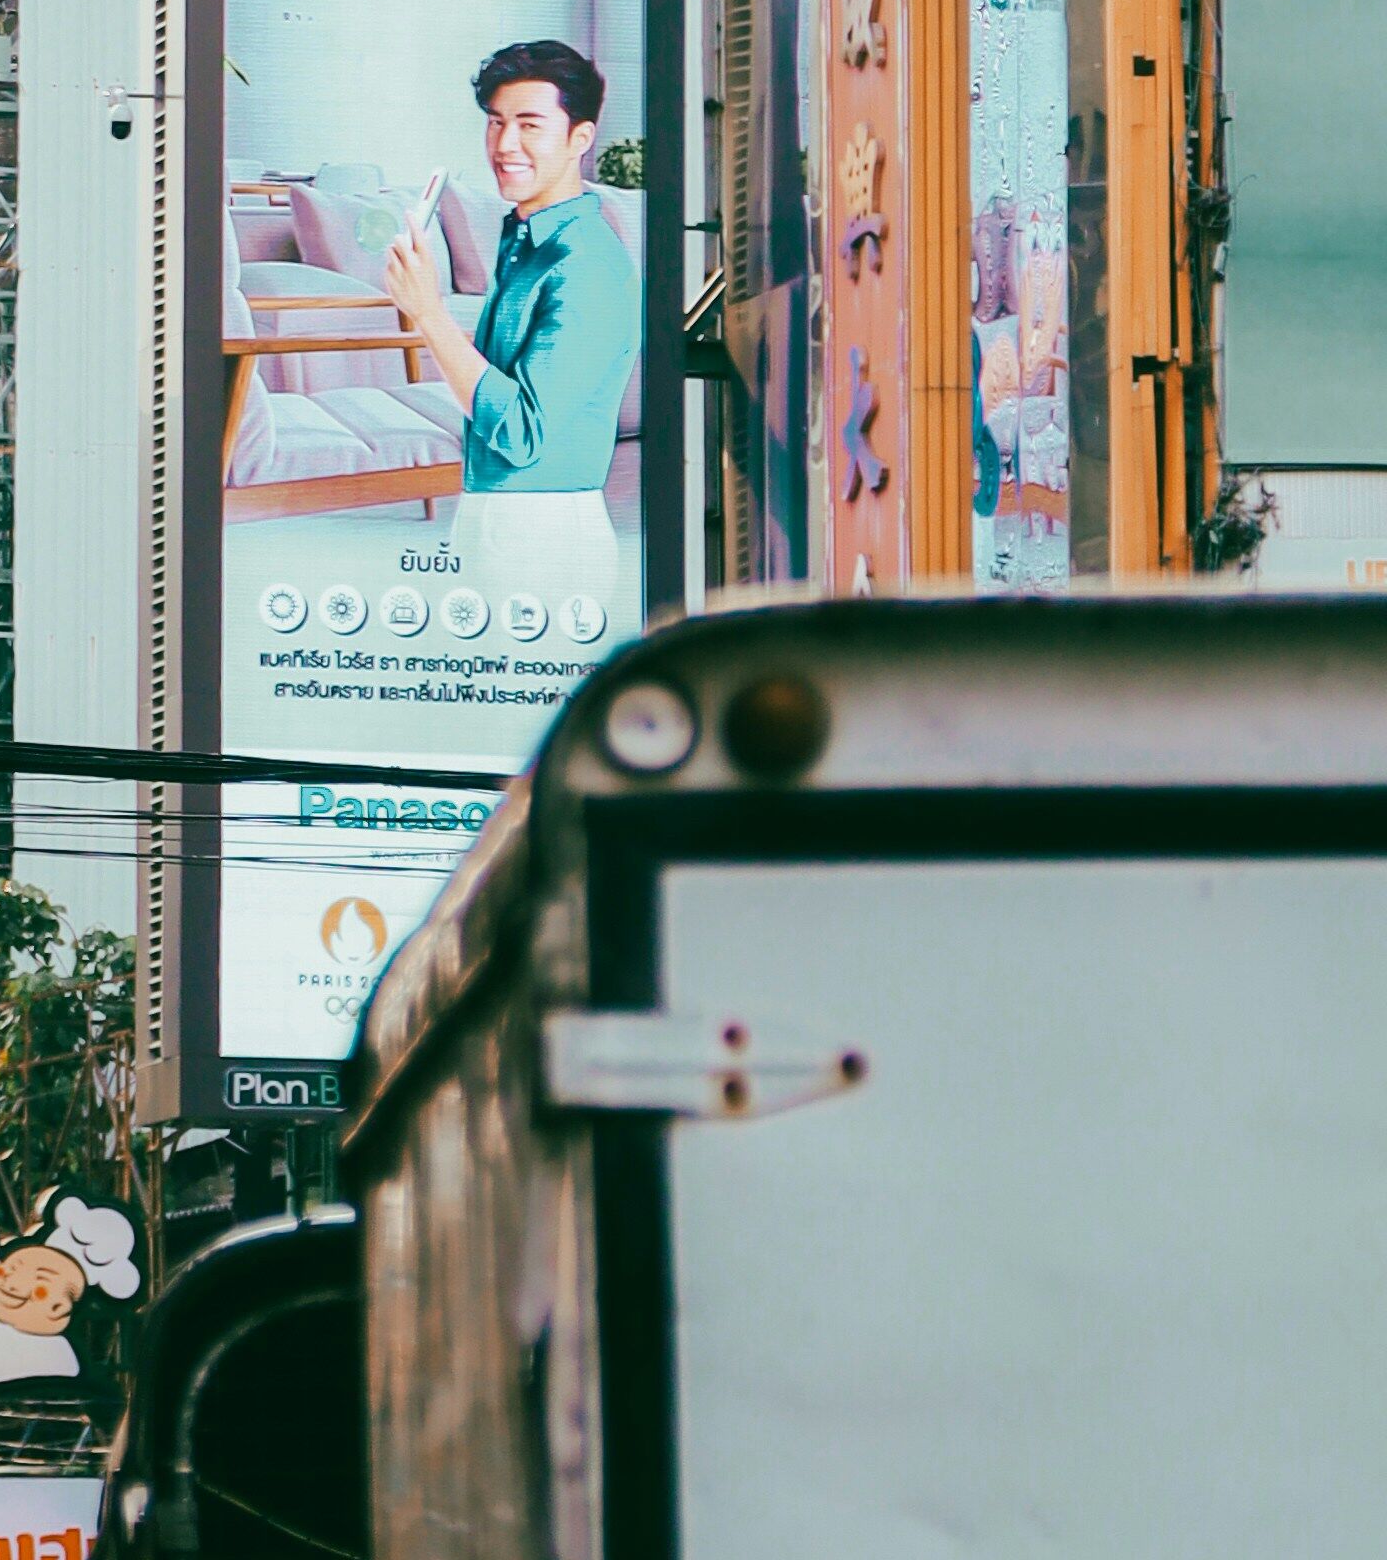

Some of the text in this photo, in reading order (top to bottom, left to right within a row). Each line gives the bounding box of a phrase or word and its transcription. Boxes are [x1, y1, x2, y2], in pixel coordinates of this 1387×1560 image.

[400, 541, 462, 574] ยับยั้ง
[299, 974, 352, 988] PARIS
